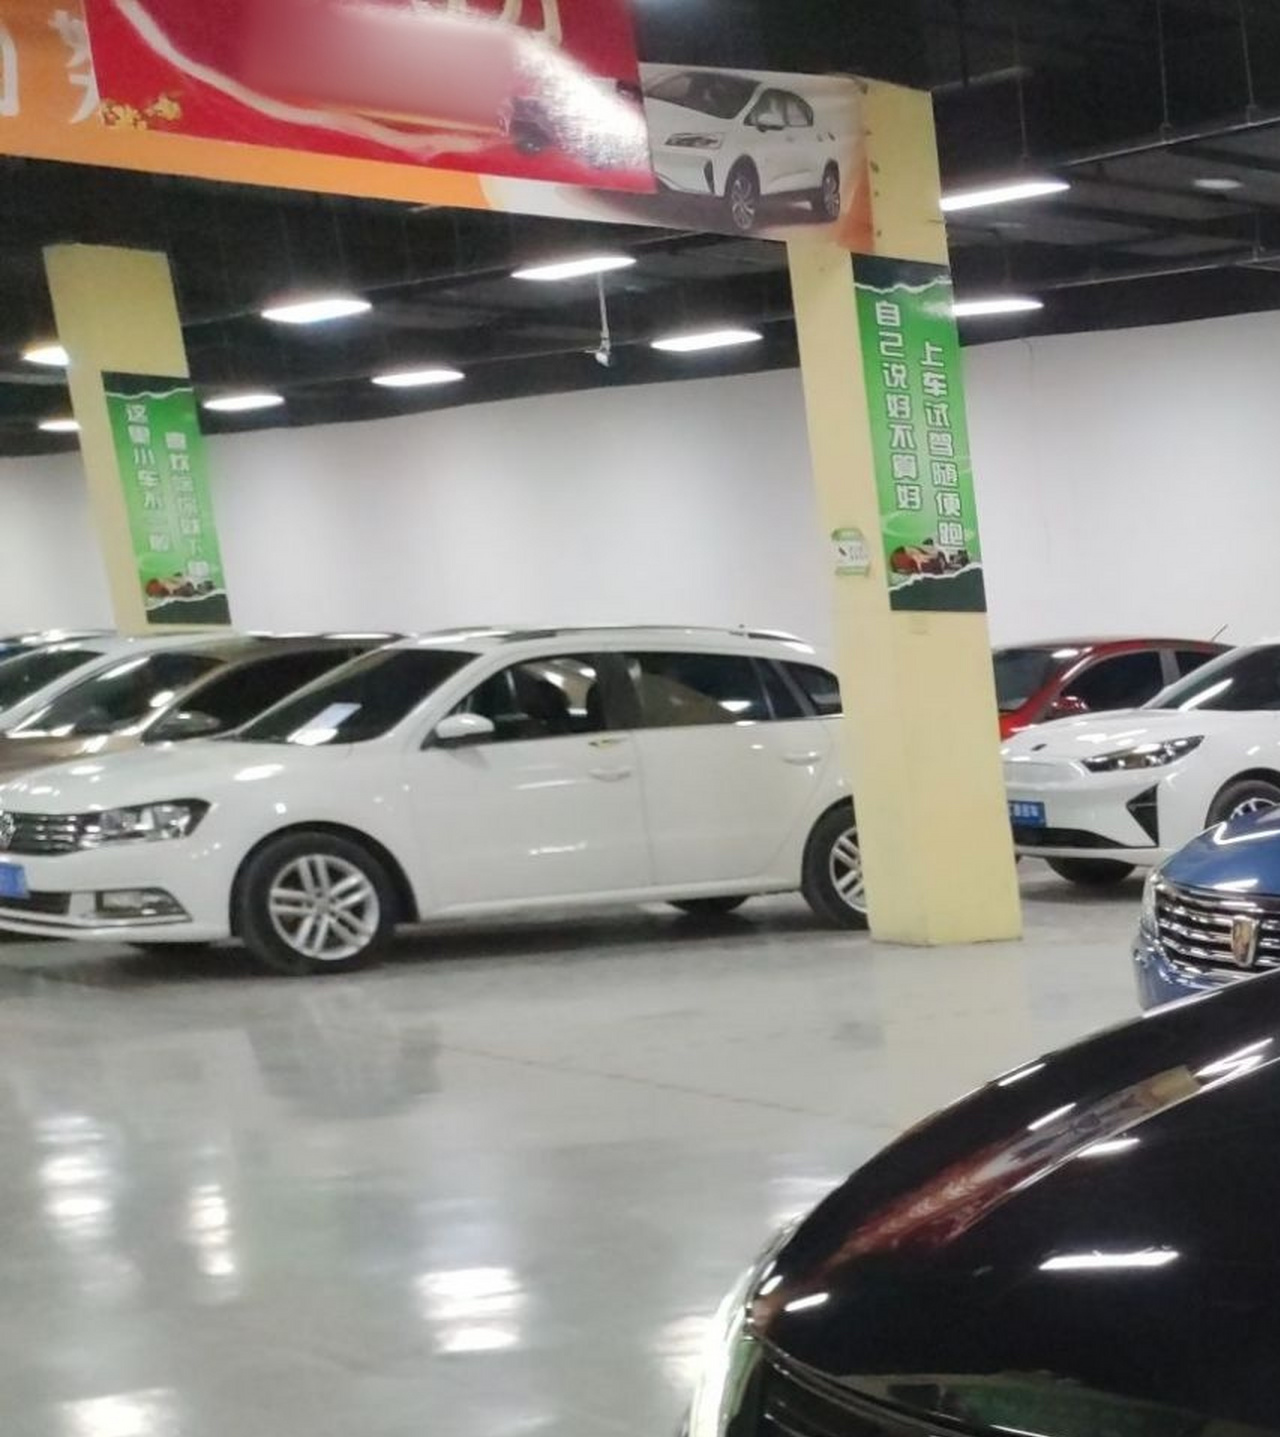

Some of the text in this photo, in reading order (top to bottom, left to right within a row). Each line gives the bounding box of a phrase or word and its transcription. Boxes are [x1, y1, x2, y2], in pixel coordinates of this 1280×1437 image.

[921, 341, 965, 550] 上车试驾随便跑
